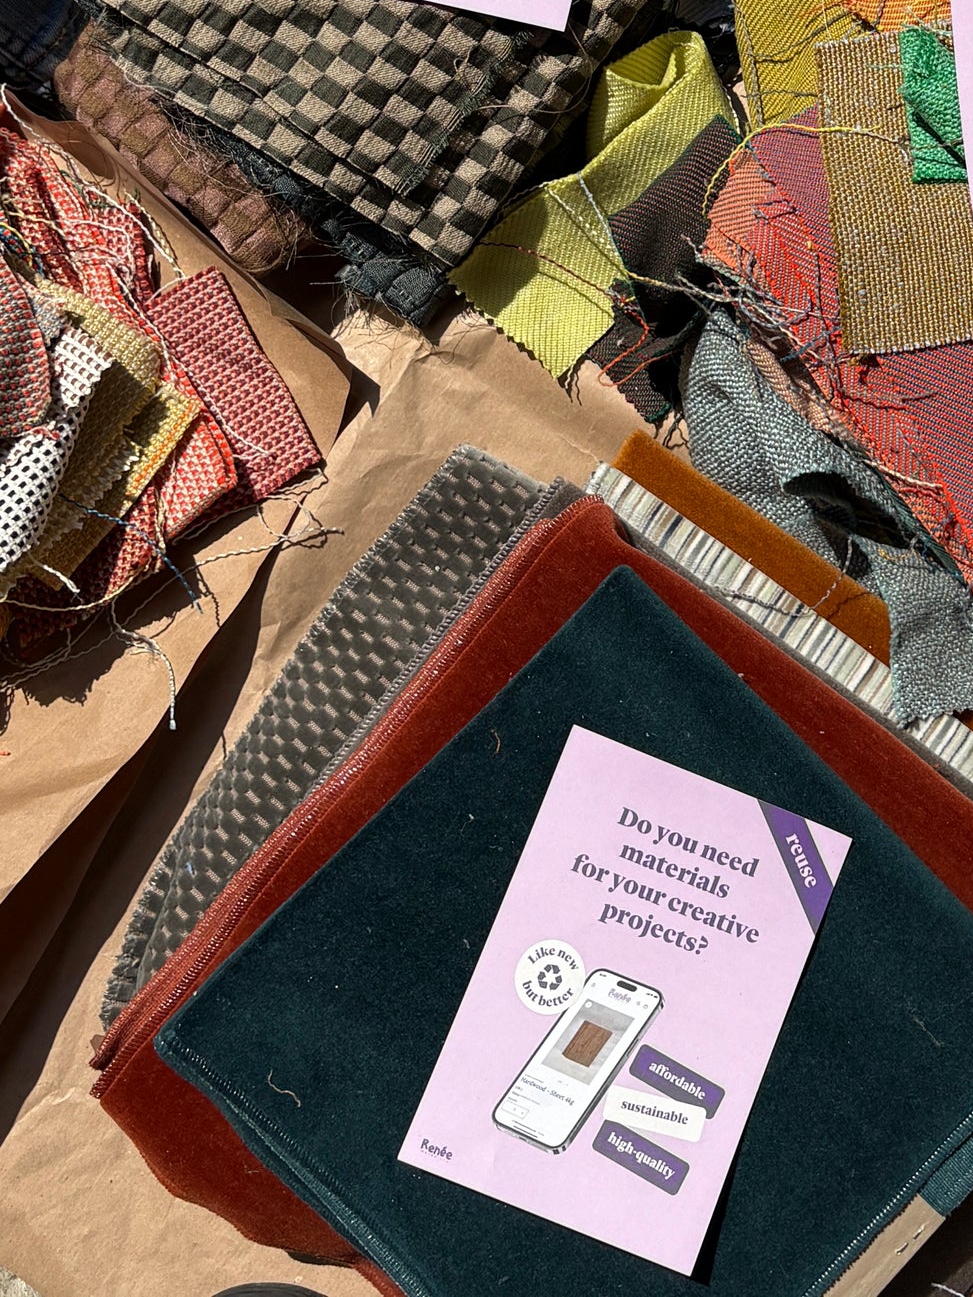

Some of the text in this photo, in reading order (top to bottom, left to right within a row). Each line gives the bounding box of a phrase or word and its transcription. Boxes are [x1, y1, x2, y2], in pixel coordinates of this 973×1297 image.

[617, 807, 760, 877] Do you need
[785, 833, 816, 888] reuse
[619, 845, 730, 898] materials
[571, 854, 759, 943] for your creative
[598, 903, 709, 955] projects?
[526, 946, 580, 971] Like new
[521, 979, 575, 1008] but better
[649, 1063, 705, 1100] affordable
[620, 1101, 689, 1125] sustainable
[607, 1132, 675, 1180] high-quality
